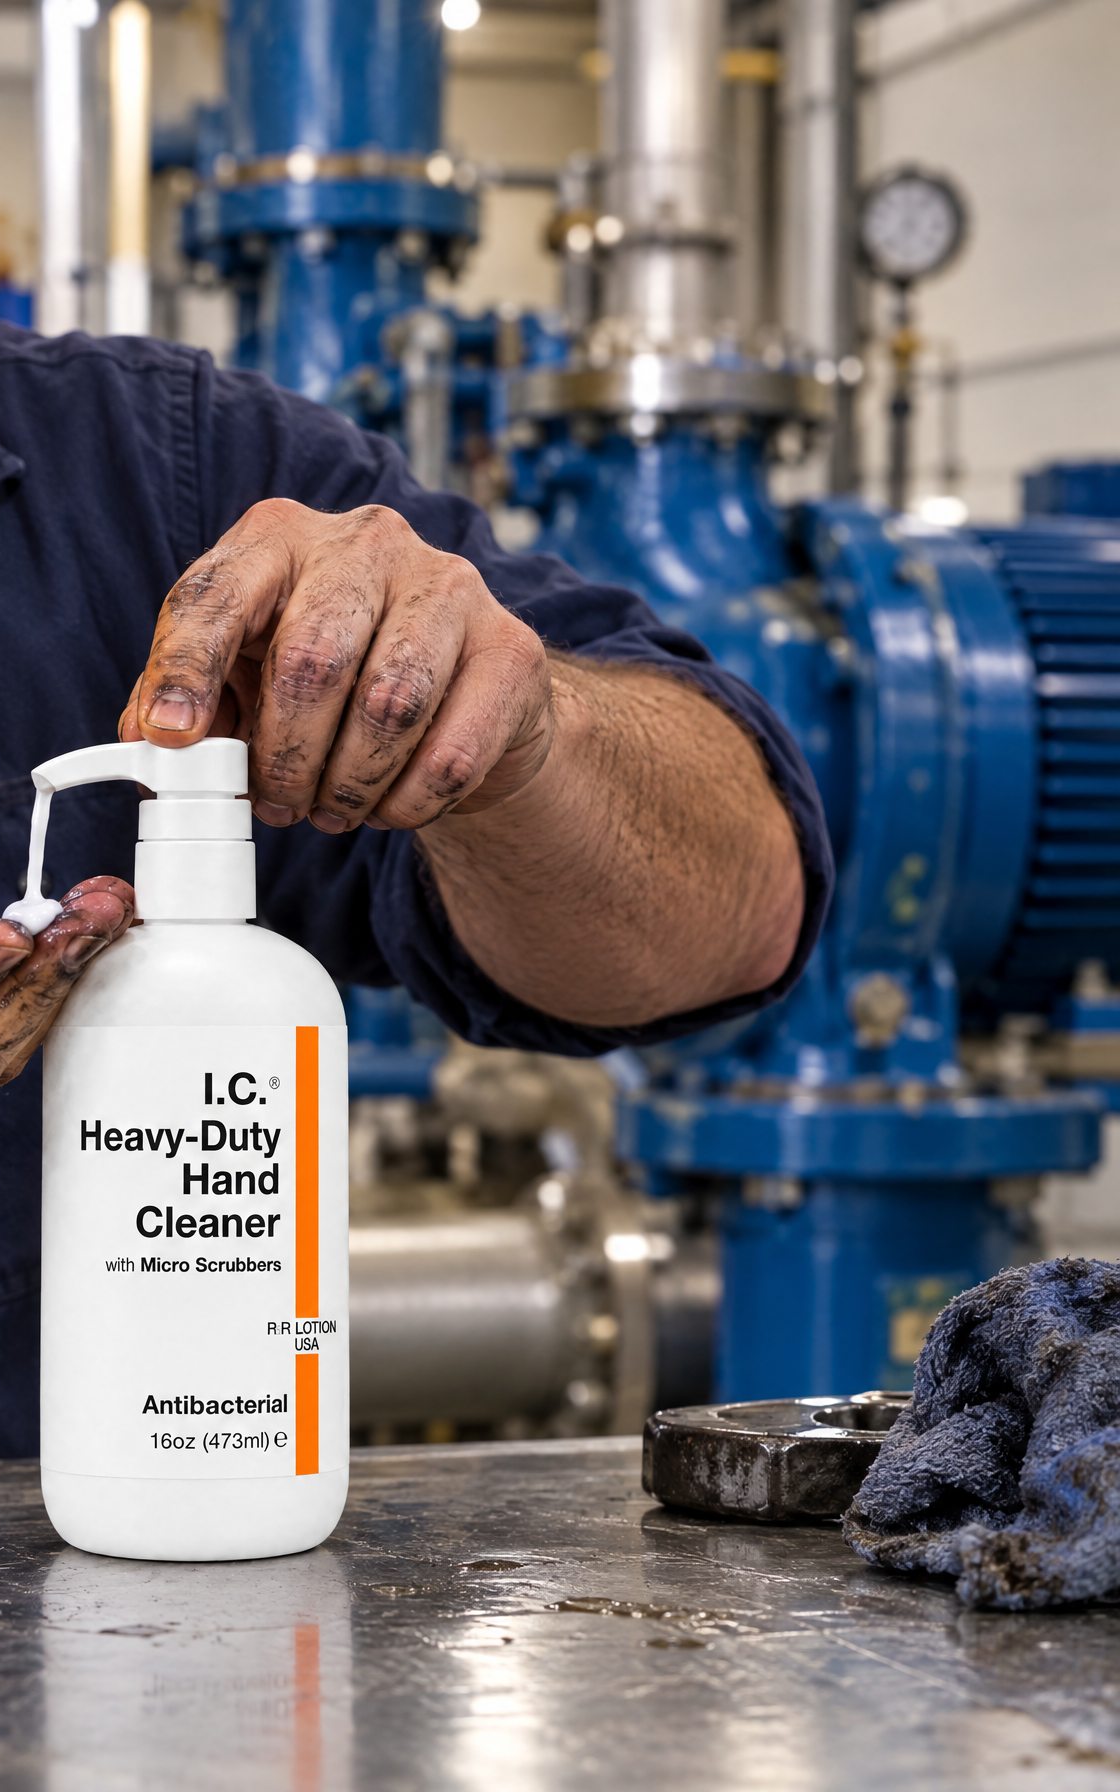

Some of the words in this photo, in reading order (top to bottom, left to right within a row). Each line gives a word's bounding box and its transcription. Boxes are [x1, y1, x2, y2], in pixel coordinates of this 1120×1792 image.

[80, 1119, 282, 1159] Heavy-Duty
[182, 1162, 280, 1196] Hand
[135, 1205, 281, 1239] Cleaner
[105, 1256, 135, 1272] with
[140, 1256, 190, 1273] Micro
[195, 1256, 282, 1273] Scrubbers
[295, 1320, 337, 1335] LOTION
[294, 1337, 320, 1352] USA
[141, 1393, 288, 1415] Antibacterial
[150, 1432, 196, 1450] 16oz
[202, 1431, 270, 1454] (473ml)
